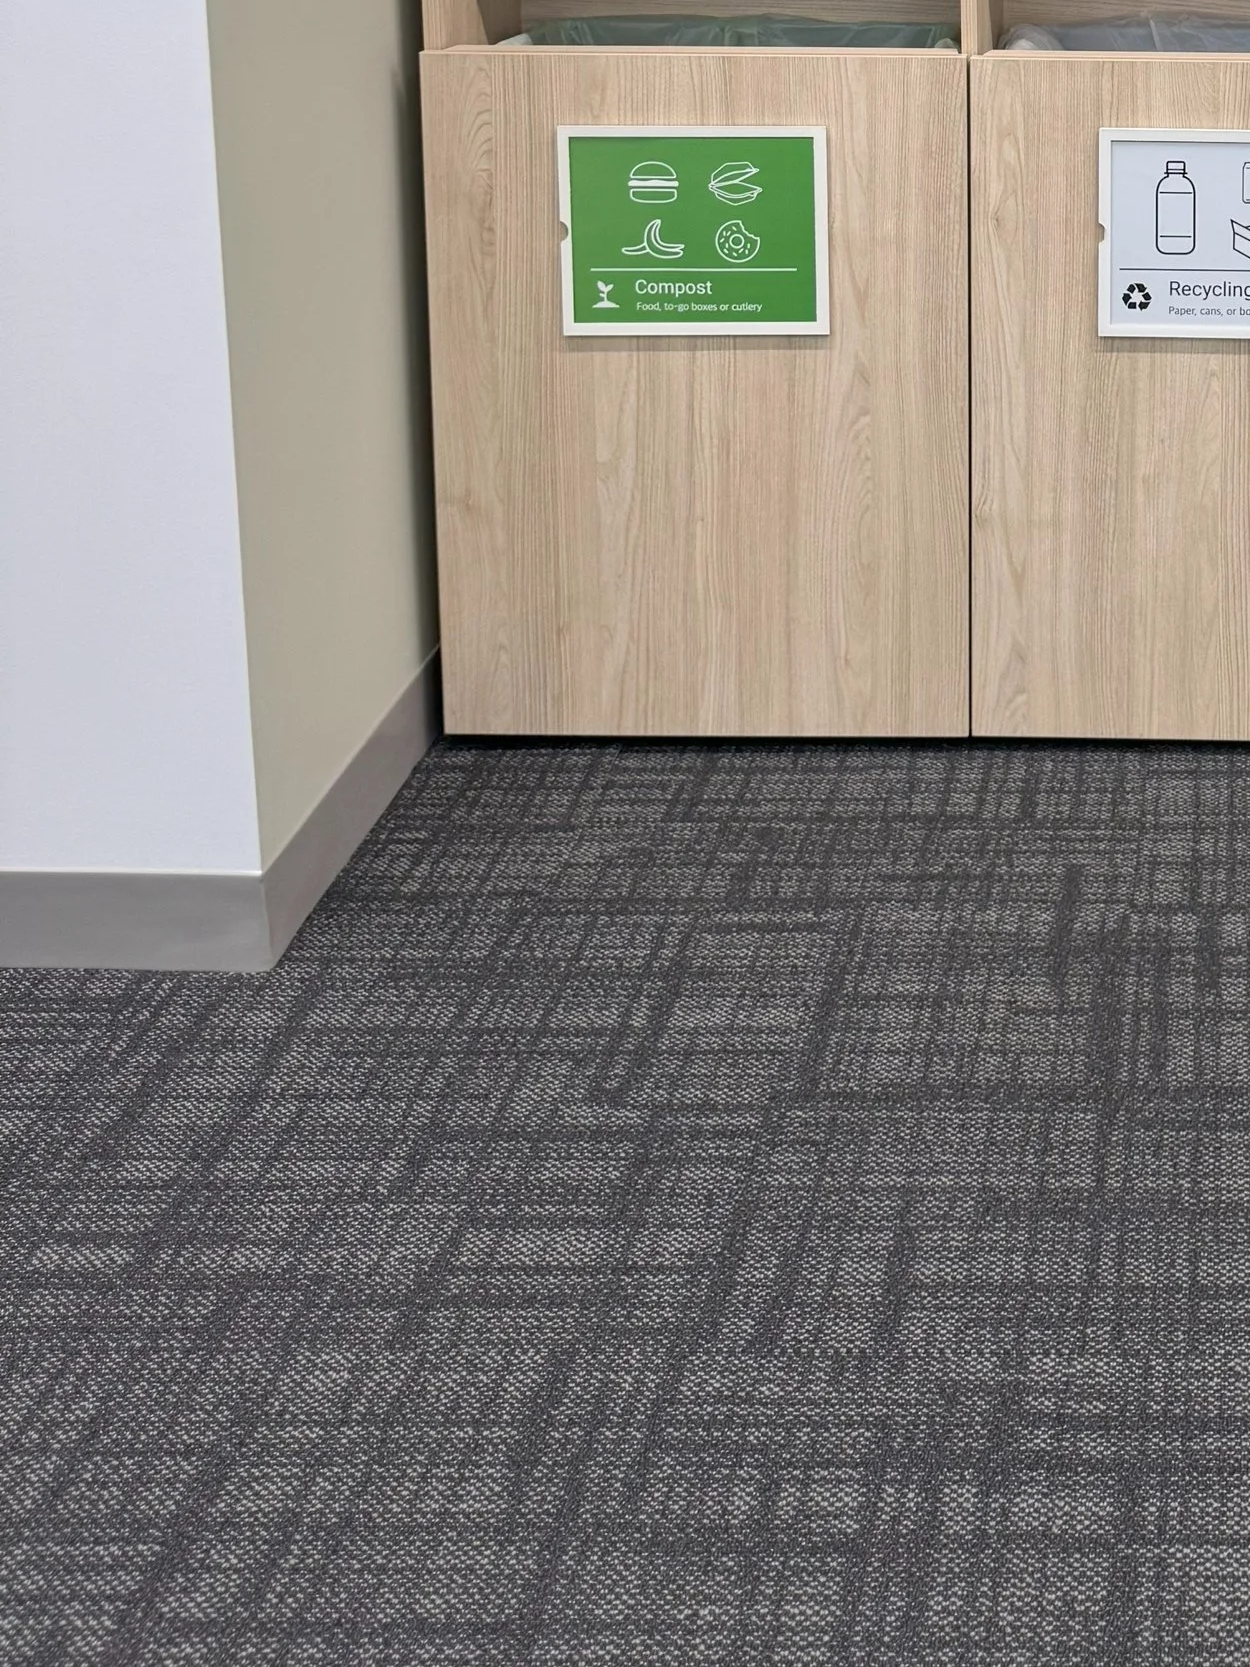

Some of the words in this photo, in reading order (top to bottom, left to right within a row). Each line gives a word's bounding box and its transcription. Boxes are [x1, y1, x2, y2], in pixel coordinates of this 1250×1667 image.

[634, 279, 713, 298] Compost
[636, 301, 662, 312] Food,
[663, 302, 690, 313] to-go
[691, 301, 718, 312] boxes
[731, 301, 763, 313] cutlery
[1168, 305, 1197, 317] Paper,
[1199, 308, 1224, 318] cans,
[1226, 308, 1237, 316] or
